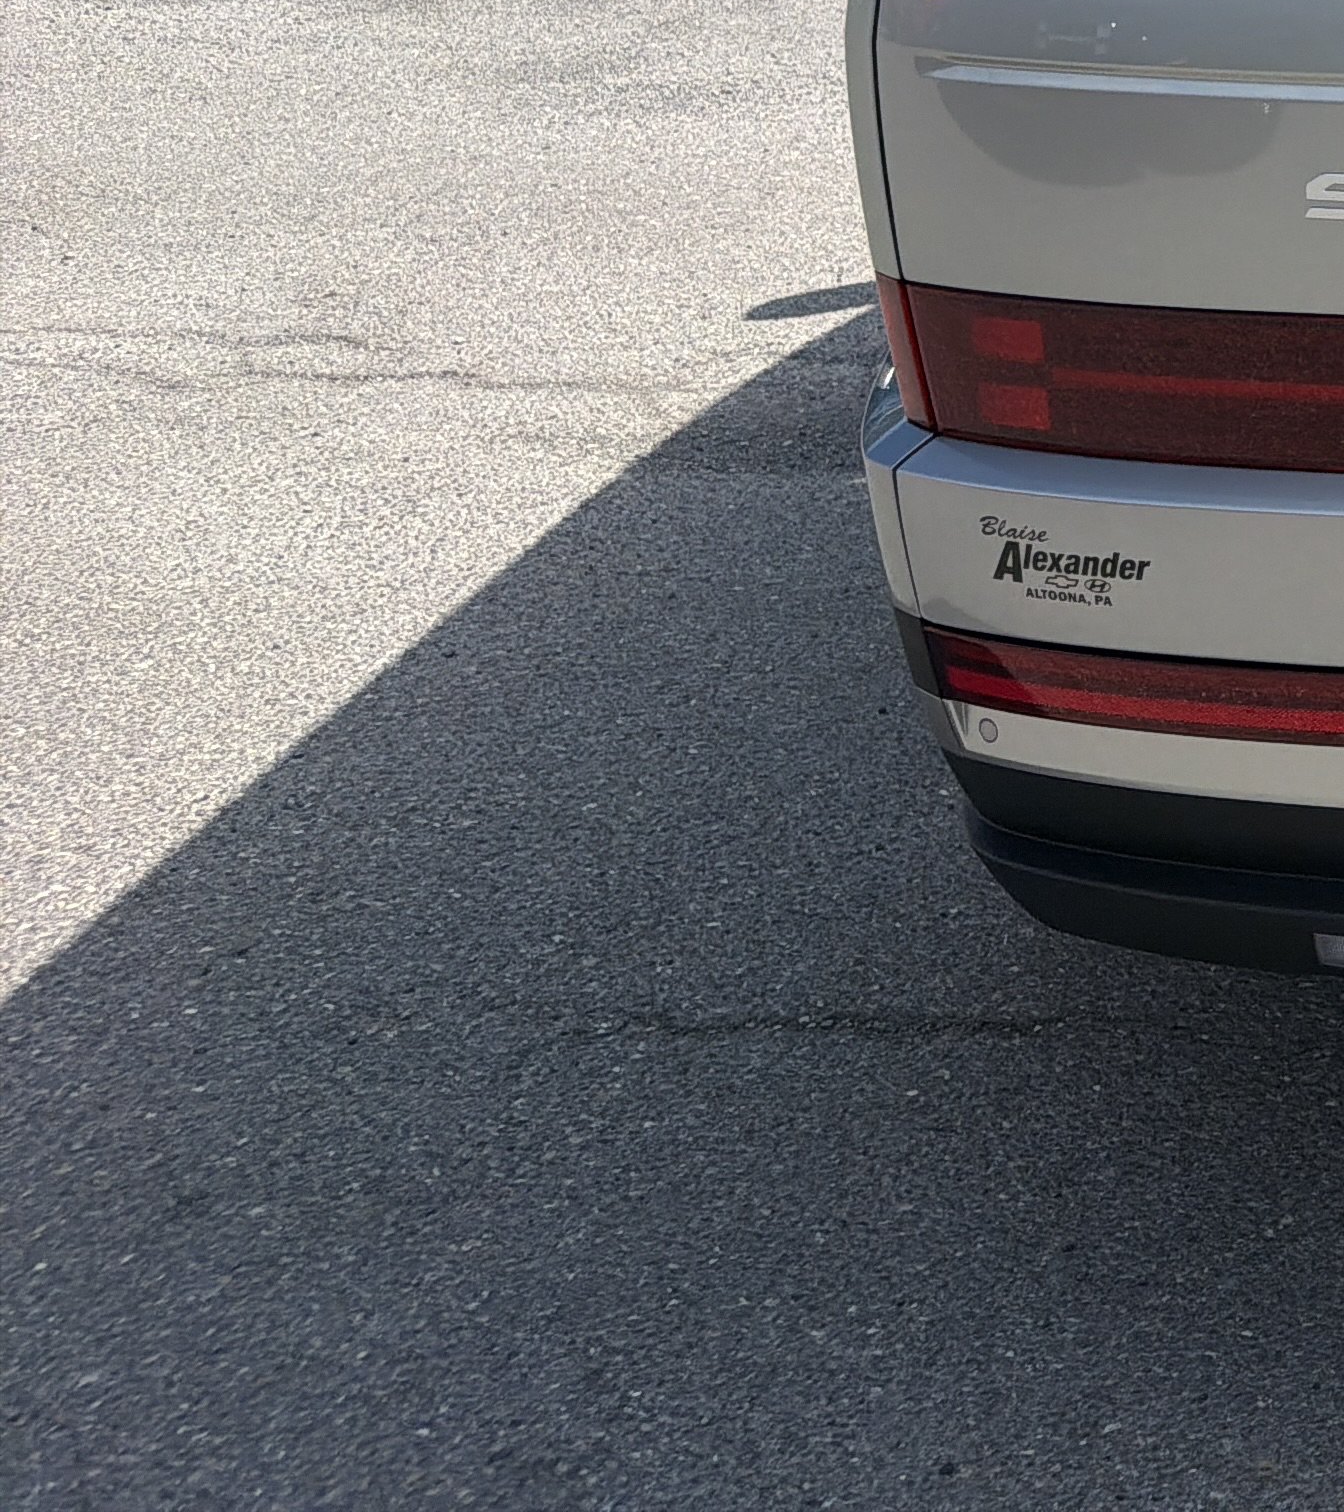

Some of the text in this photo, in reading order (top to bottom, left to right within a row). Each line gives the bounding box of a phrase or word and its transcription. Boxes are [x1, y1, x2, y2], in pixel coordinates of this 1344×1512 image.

[979, 515, 1050, 543] Blaise
[992, 540, 1151, 584] Alexander
[1025, 587, 1113, 607] ALTOONA, PA
